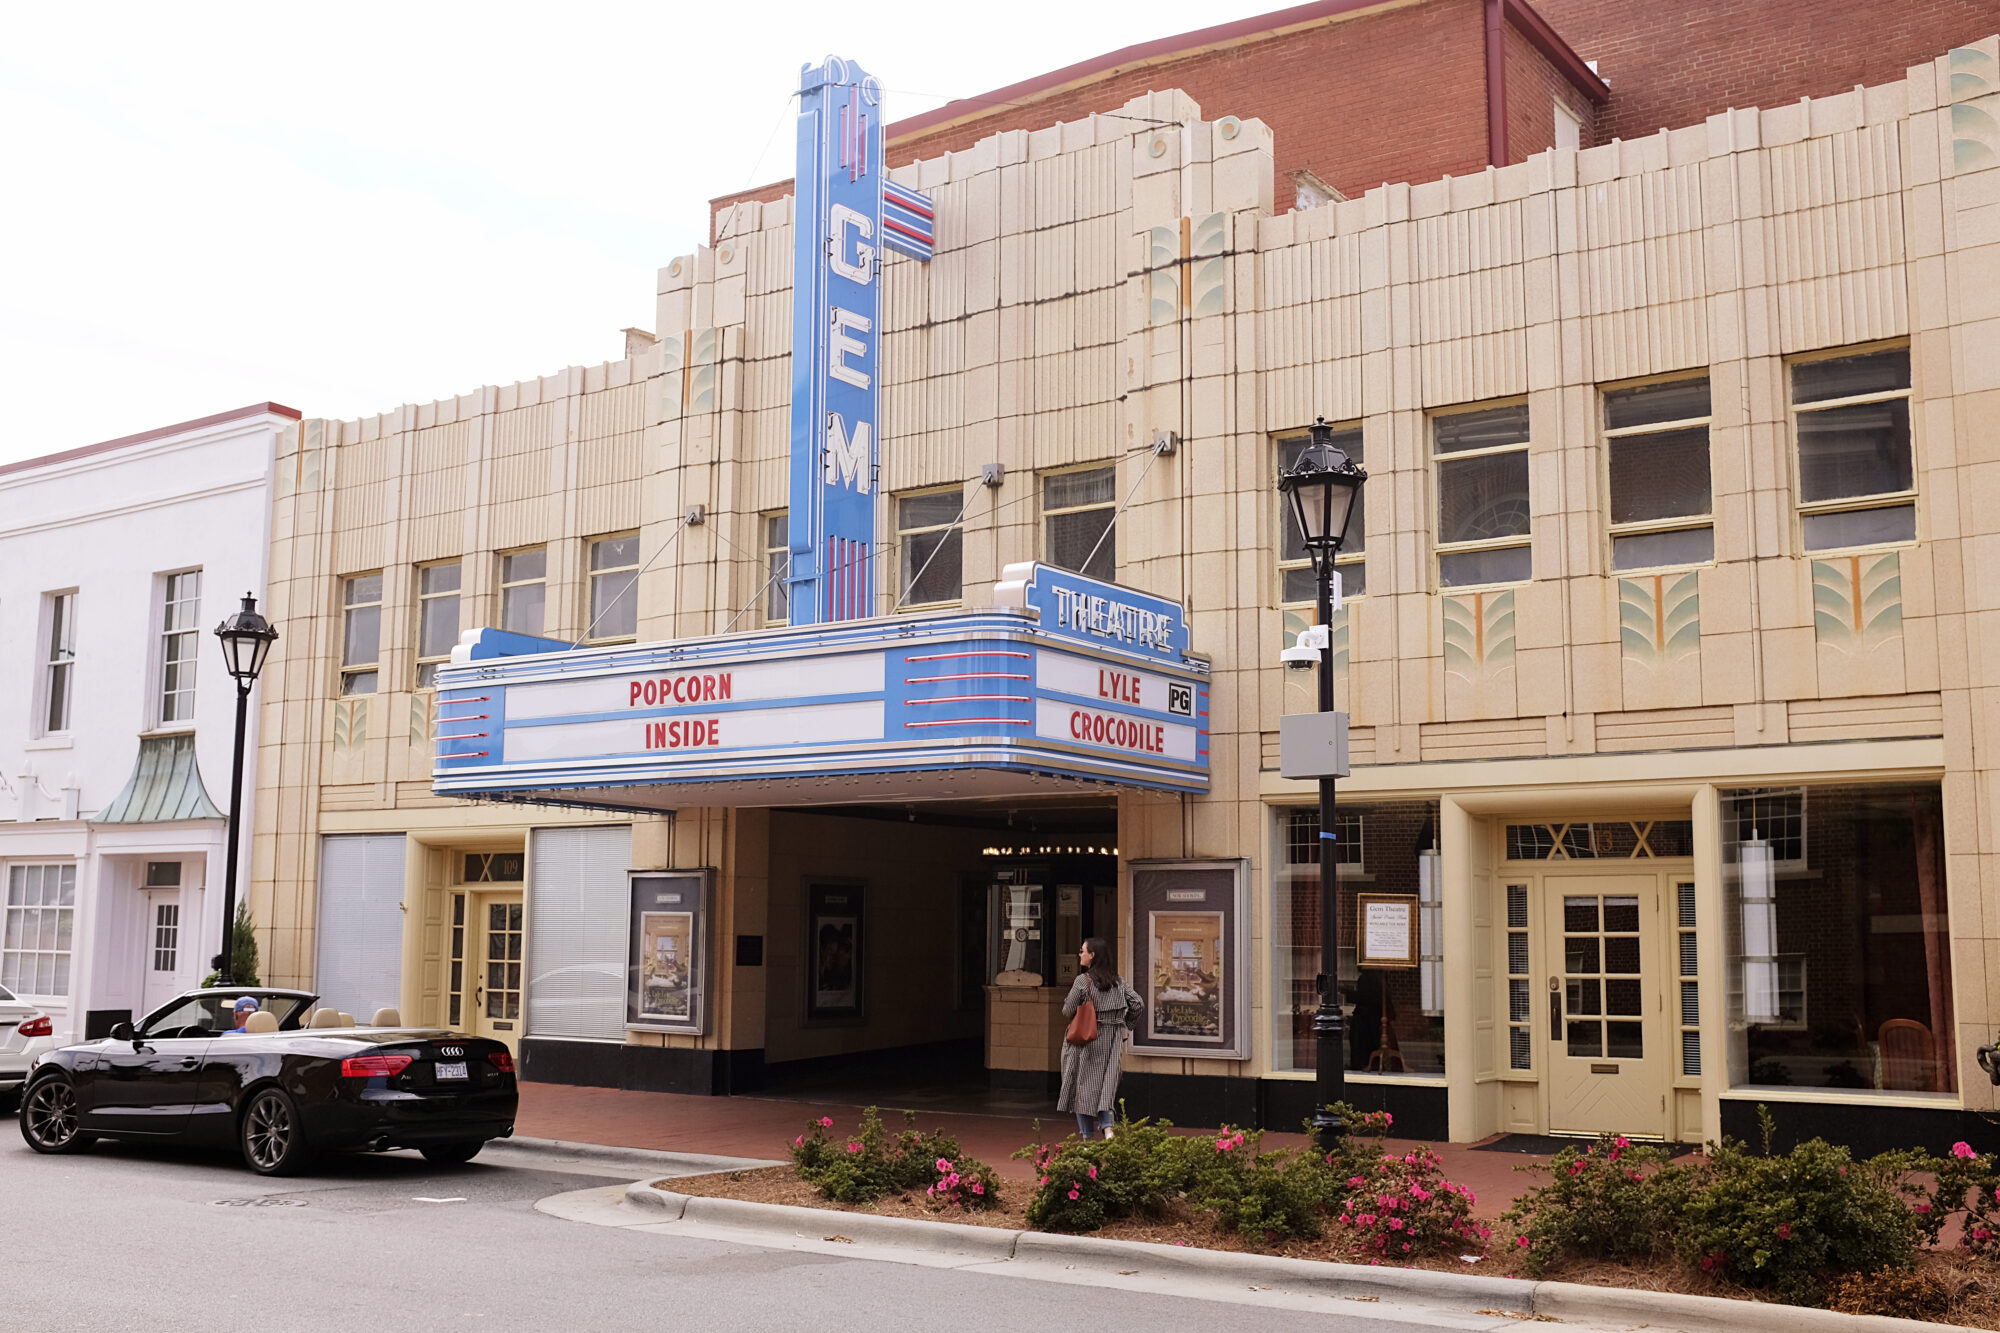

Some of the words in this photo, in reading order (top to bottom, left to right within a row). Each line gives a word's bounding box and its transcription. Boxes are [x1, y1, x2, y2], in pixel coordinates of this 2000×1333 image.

[825, 202, 875, 496] GEM
[1052, 585, 1174, 653] THEATRE
[630, 673, 731, 707] POPCORN
[1099, 669, 1140, 704] LYLE
[1171, 688, 1189, 711] PG
[646, 719, 719, 749] INSIDE
[1070, 711, 1164, 752] CROCODILE
[1588, 830, 1613, 852] 113
[504, 859, 518, 875] 109
